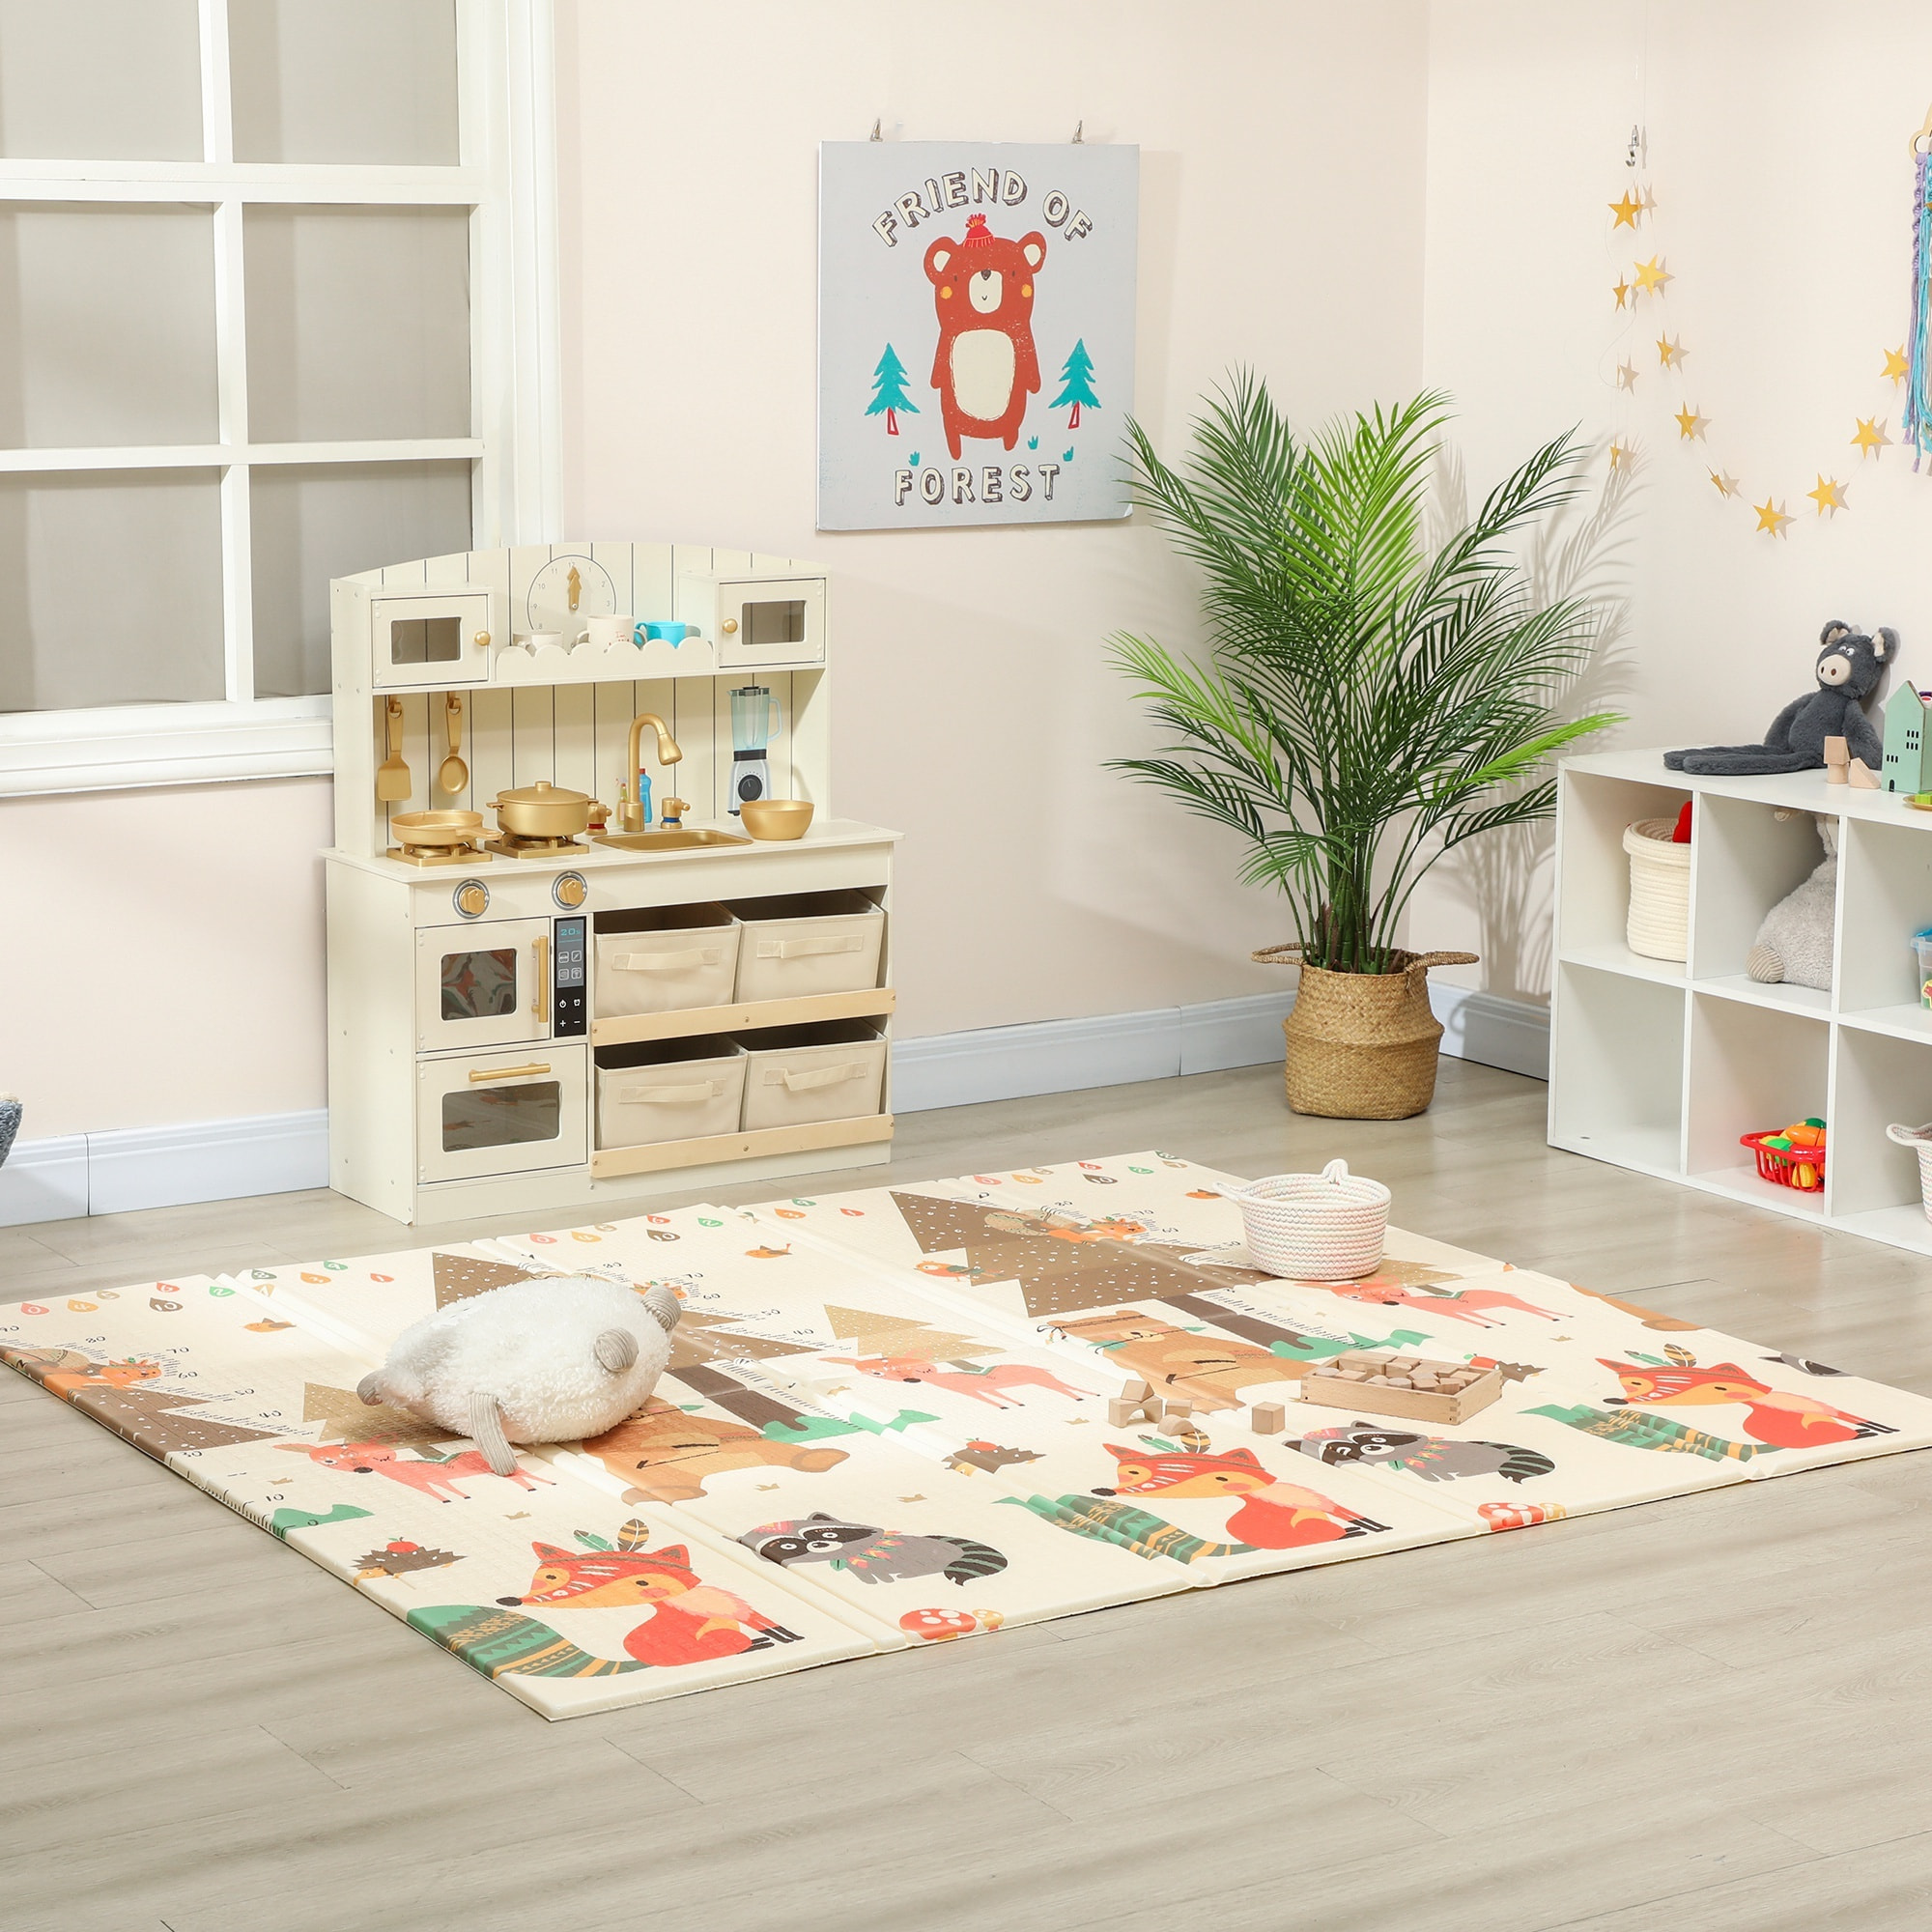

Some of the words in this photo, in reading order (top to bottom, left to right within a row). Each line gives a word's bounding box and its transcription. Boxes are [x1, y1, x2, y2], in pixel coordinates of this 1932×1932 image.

[871, 167, 1028, 247] FRIEND
[1042, 189, 1094, 242] OF
[894, 464, 1060, 506] FOREST
[1091, 1176, 1114, 1184] 10
[653, 1233, 676, 1241] 10
[155, 1301, 178, 1312] 10
[234, 1387, 255, 1396] 50
[259, 1410, 282, 1419] 40
[265, 1493, 285, 1502] 10
